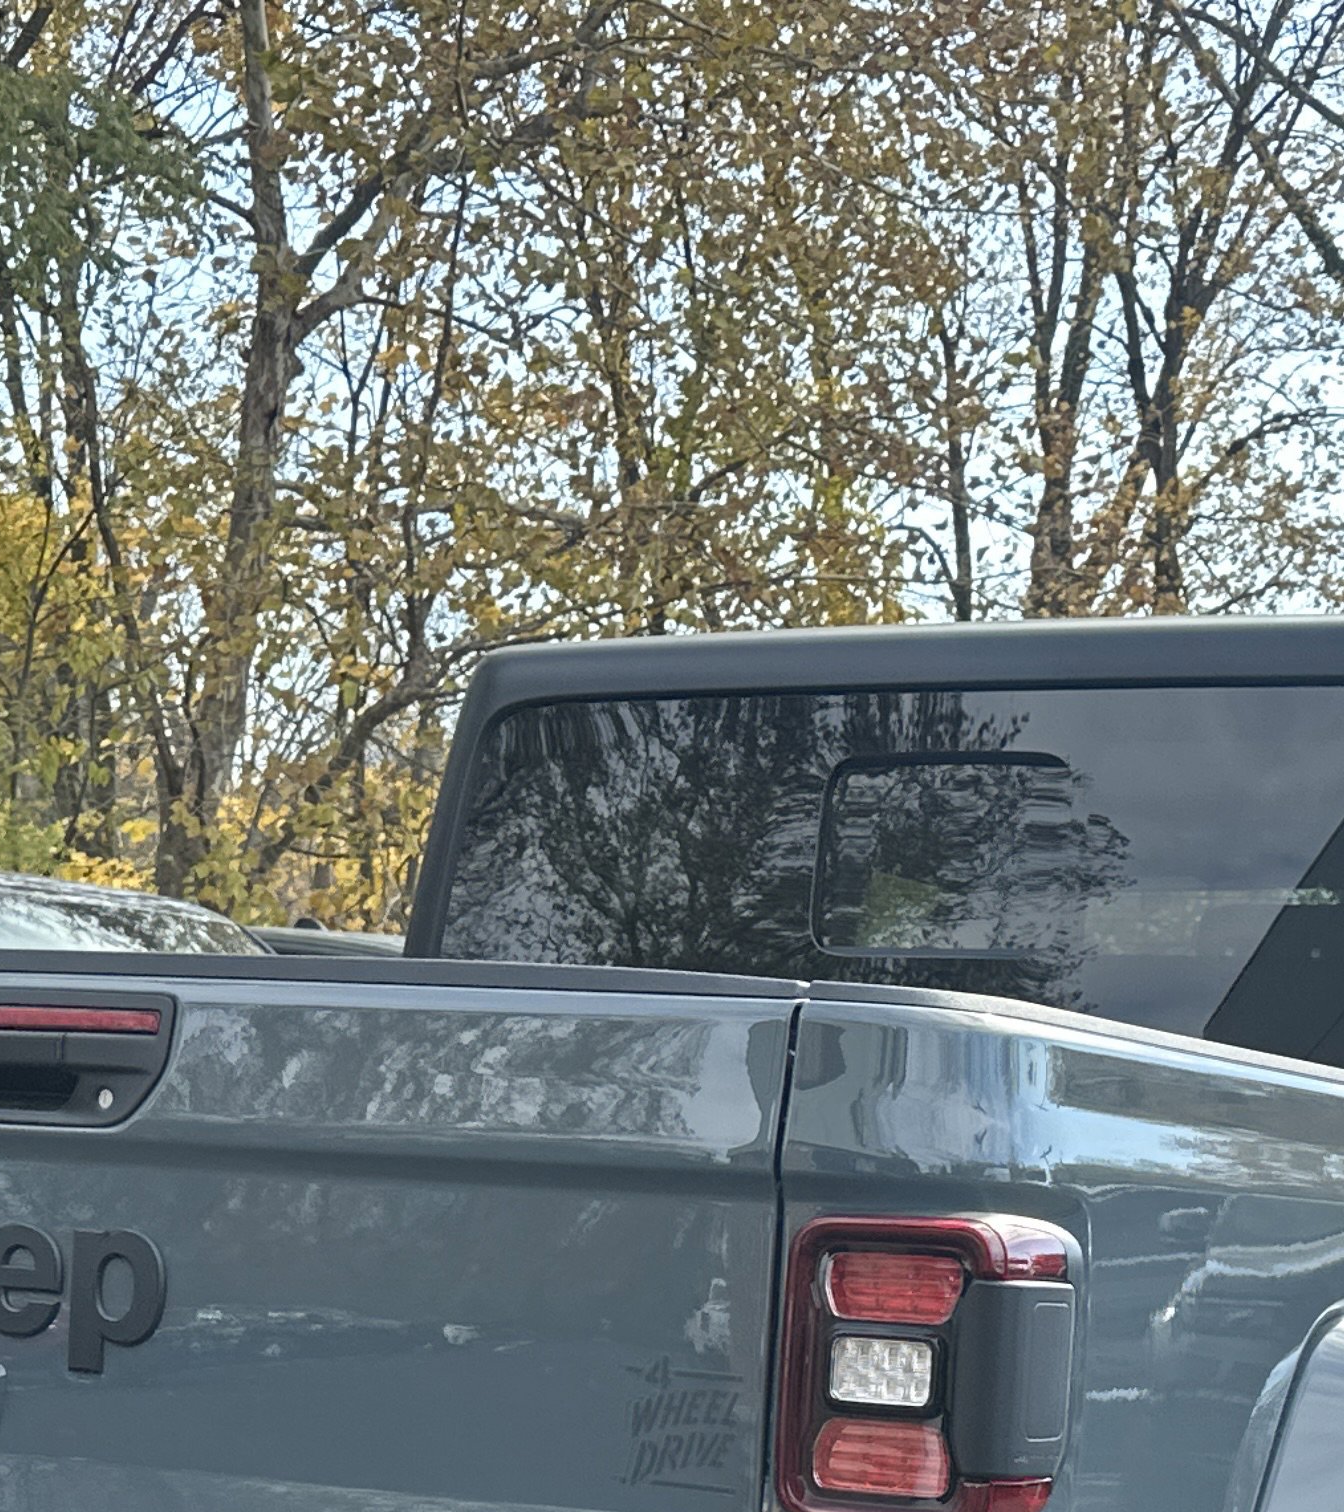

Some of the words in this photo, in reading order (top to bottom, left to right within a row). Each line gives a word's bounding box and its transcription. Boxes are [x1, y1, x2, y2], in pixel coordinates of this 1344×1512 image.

[644, 1355, 671, 1390] 4
[630, 1390, 740, 1437] WHEEL
[629, 1432, 738, 1487] DRIVE
